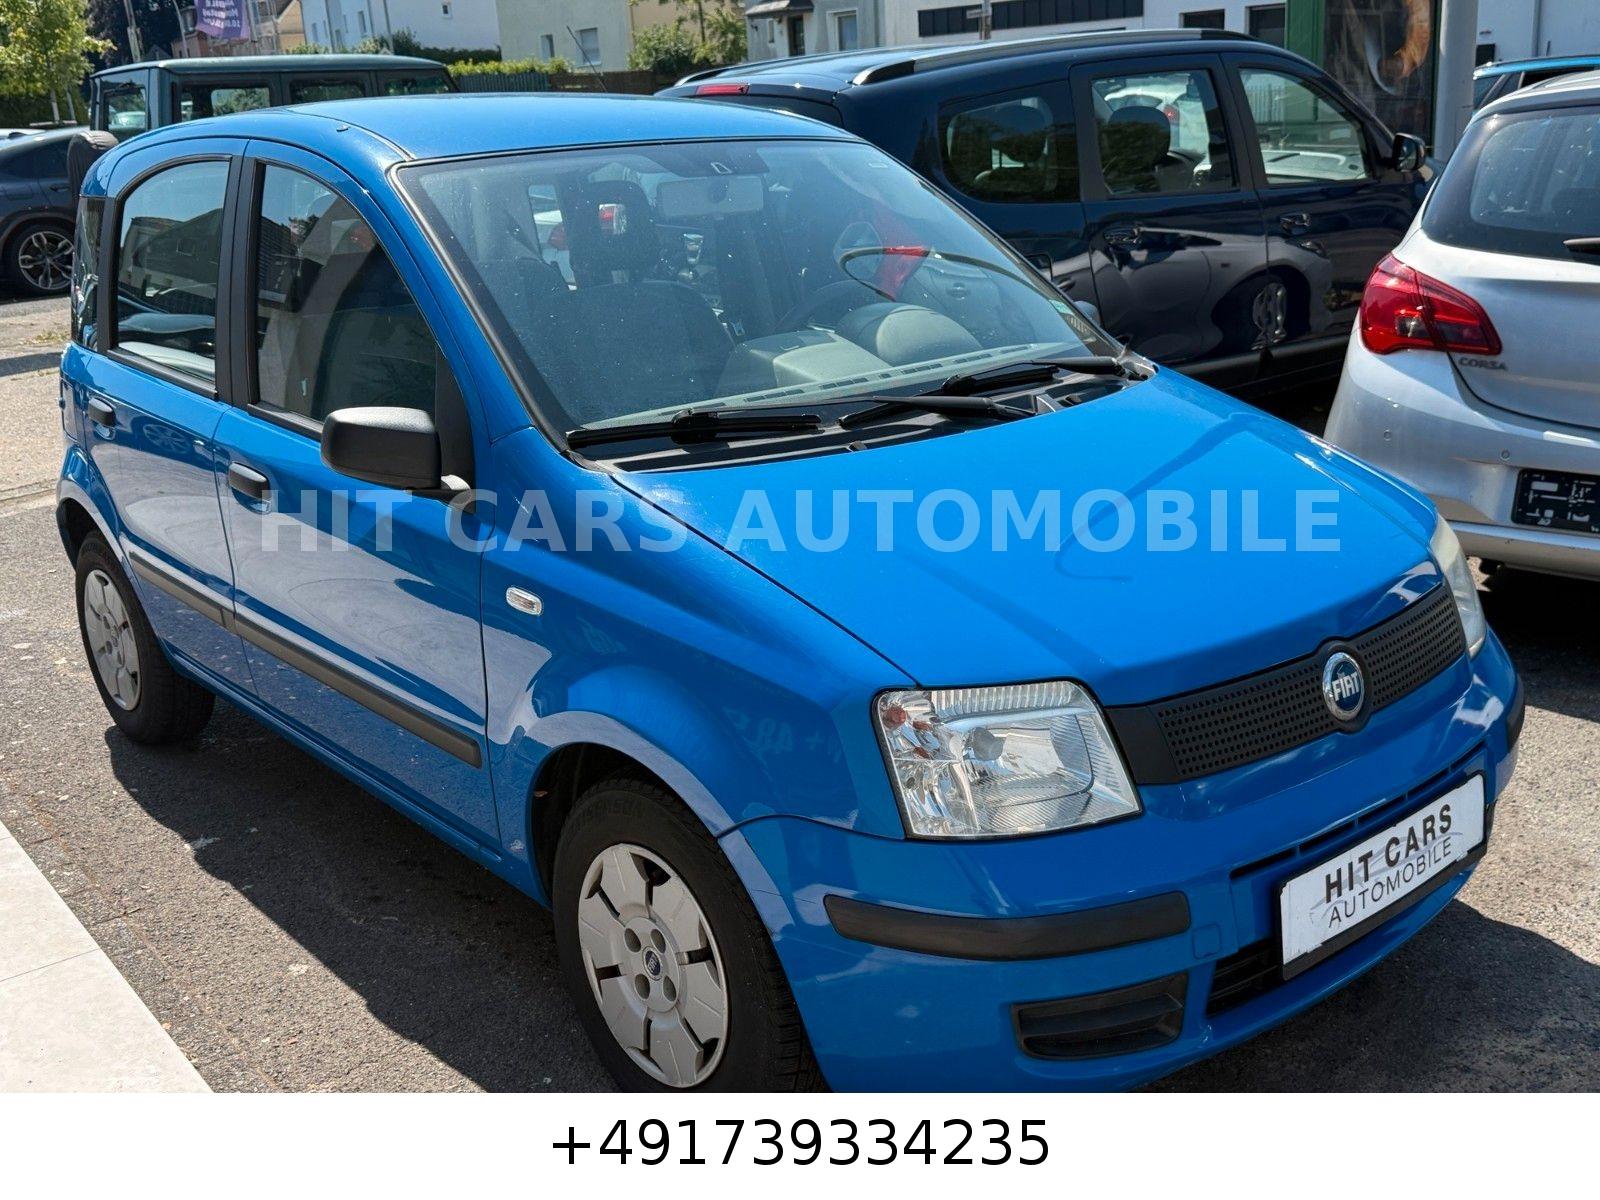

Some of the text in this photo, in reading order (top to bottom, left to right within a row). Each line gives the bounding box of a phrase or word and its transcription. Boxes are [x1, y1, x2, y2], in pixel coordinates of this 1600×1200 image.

[1459, 357, 1507, 371] CORSA
[1332, 672, 1360, 701] FIAT
[1325, 804, 1452, 904] HIT CARS
[1328, 837, 1452, 929] AUTOMOBILE
